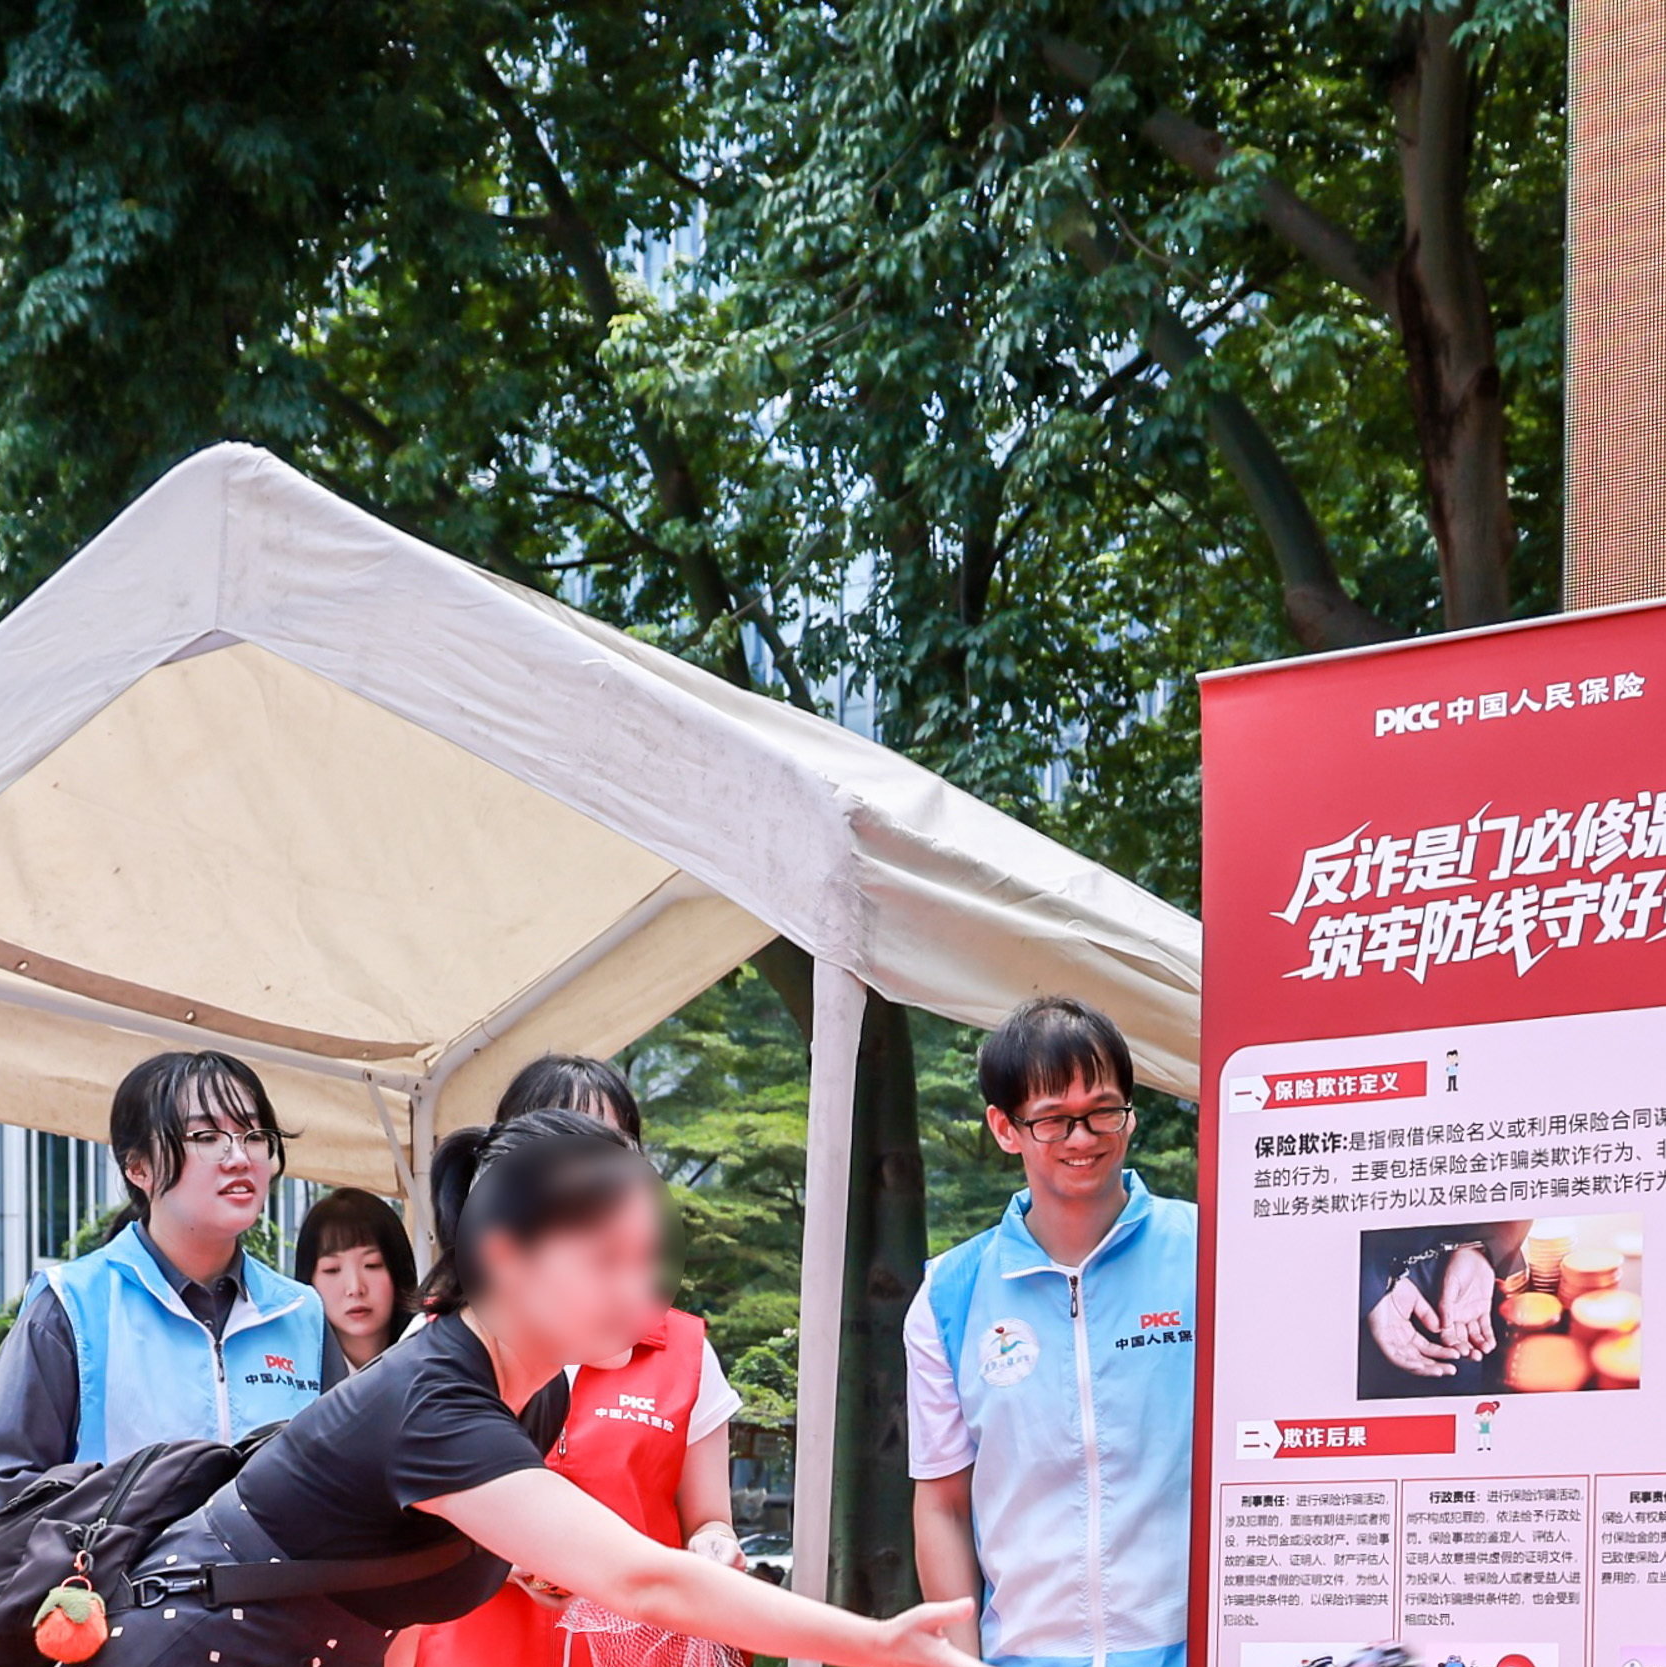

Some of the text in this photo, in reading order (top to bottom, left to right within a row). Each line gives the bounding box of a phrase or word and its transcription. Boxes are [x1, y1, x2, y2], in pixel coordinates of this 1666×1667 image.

[1374, 671, 1647, 738] PICC 中国人民保险
[1140, 1311, 1181, 1330] PICC
[618, 1394, 656, 1412] PICC
[594, 1407, 675, 1433] 中国人民保险
